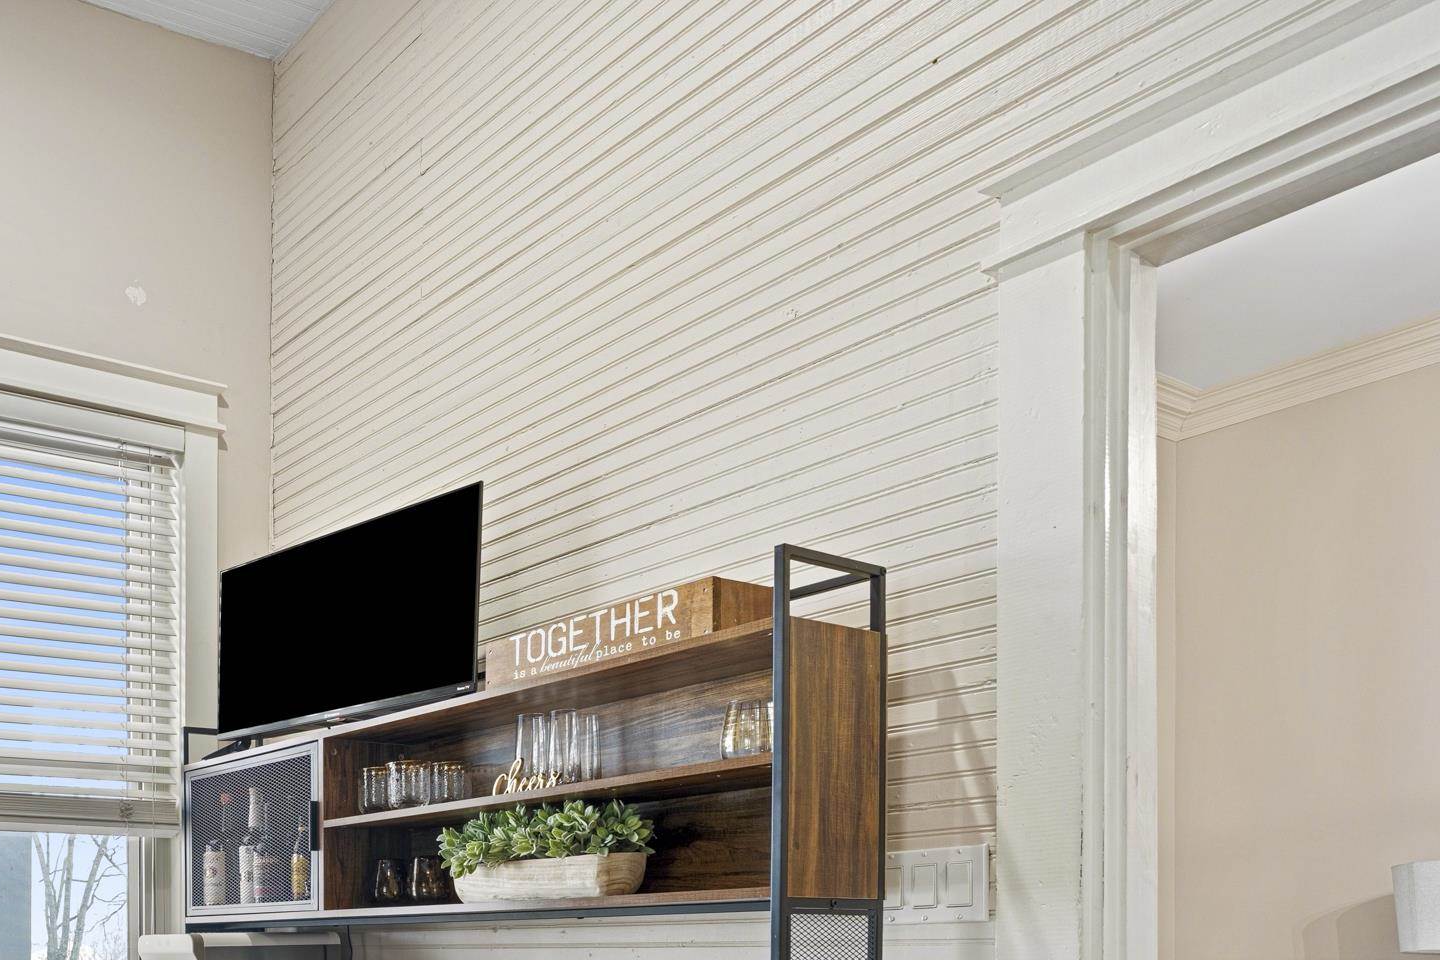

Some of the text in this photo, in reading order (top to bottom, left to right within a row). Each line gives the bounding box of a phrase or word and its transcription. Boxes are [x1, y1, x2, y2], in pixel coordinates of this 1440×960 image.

[509, 588, 679, 667] TOGETHER
[513, 629, 681, 681] is a beautiful place to be
